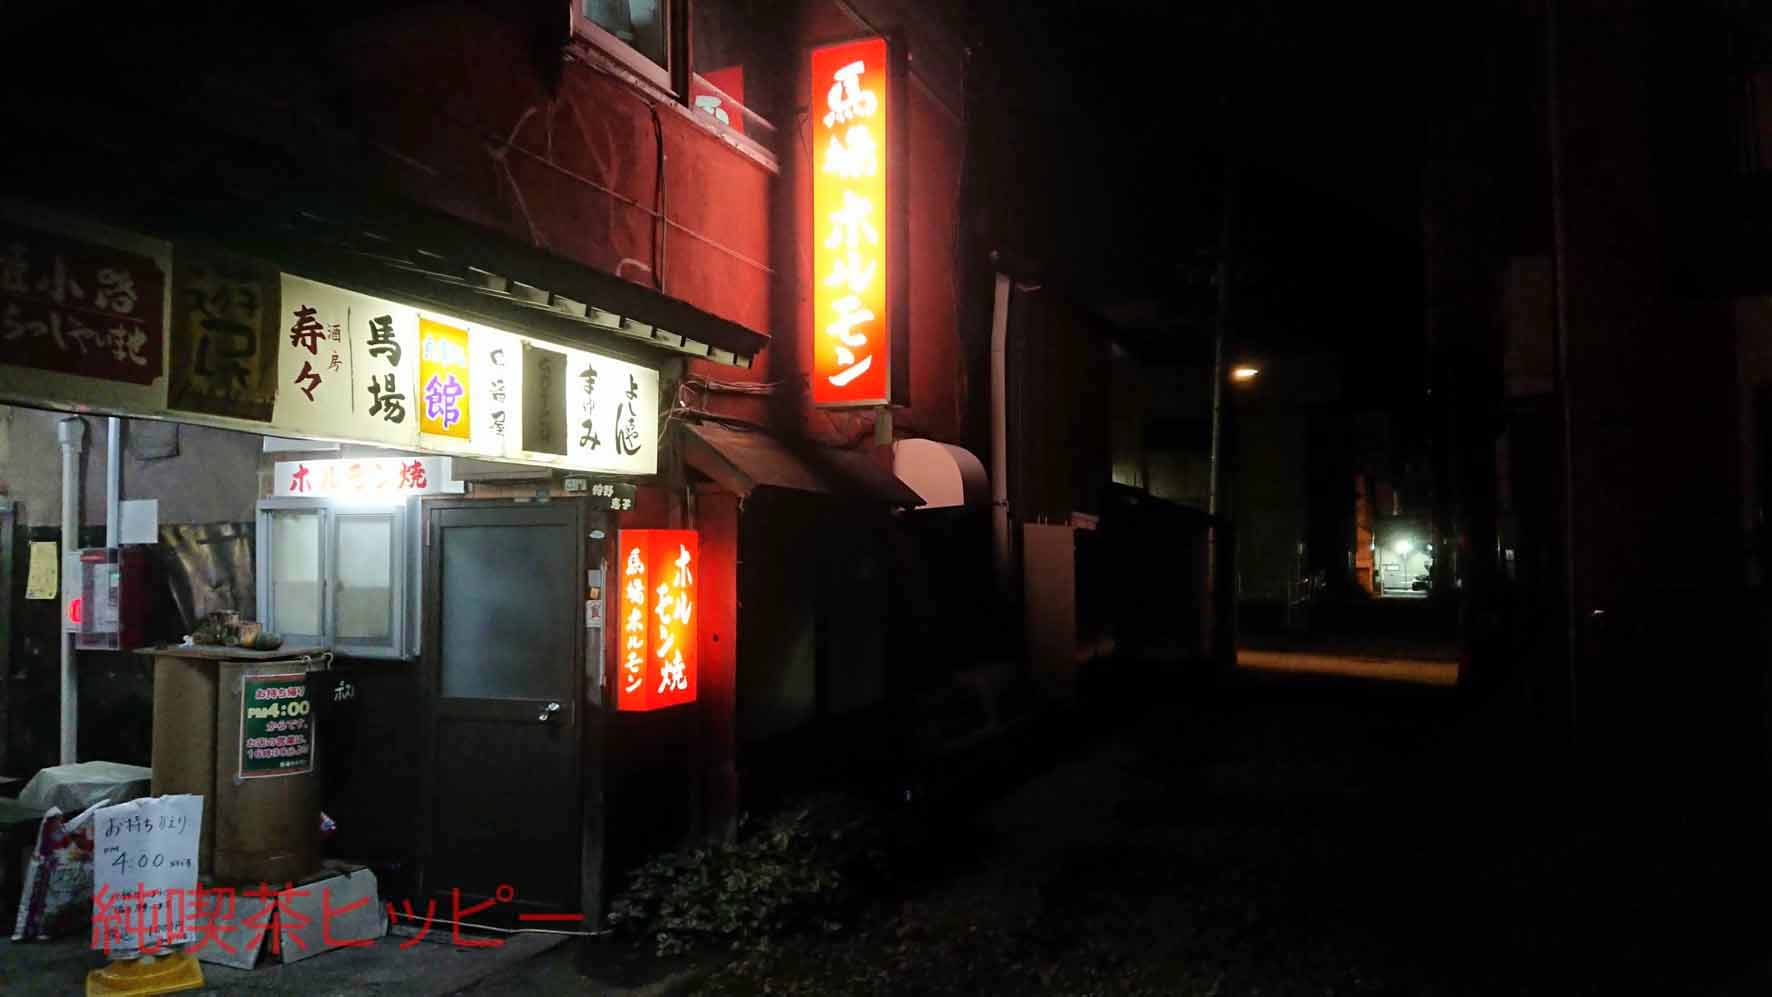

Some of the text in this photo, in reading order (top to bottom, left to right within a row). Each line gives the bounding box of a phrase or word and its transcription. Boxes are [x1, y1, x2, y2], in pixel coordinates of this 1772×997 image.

[823, 60, 879, 387] 馬場ホルモン
[289, 304, 326, 402] 寿々
[327, 323, 342, 372] 酒房
[367, 314, 406, 424] 馬場
[289, 459, 428, 493] ホルモン焼
[624, 547, 645, 693] 馬場ホルモン
